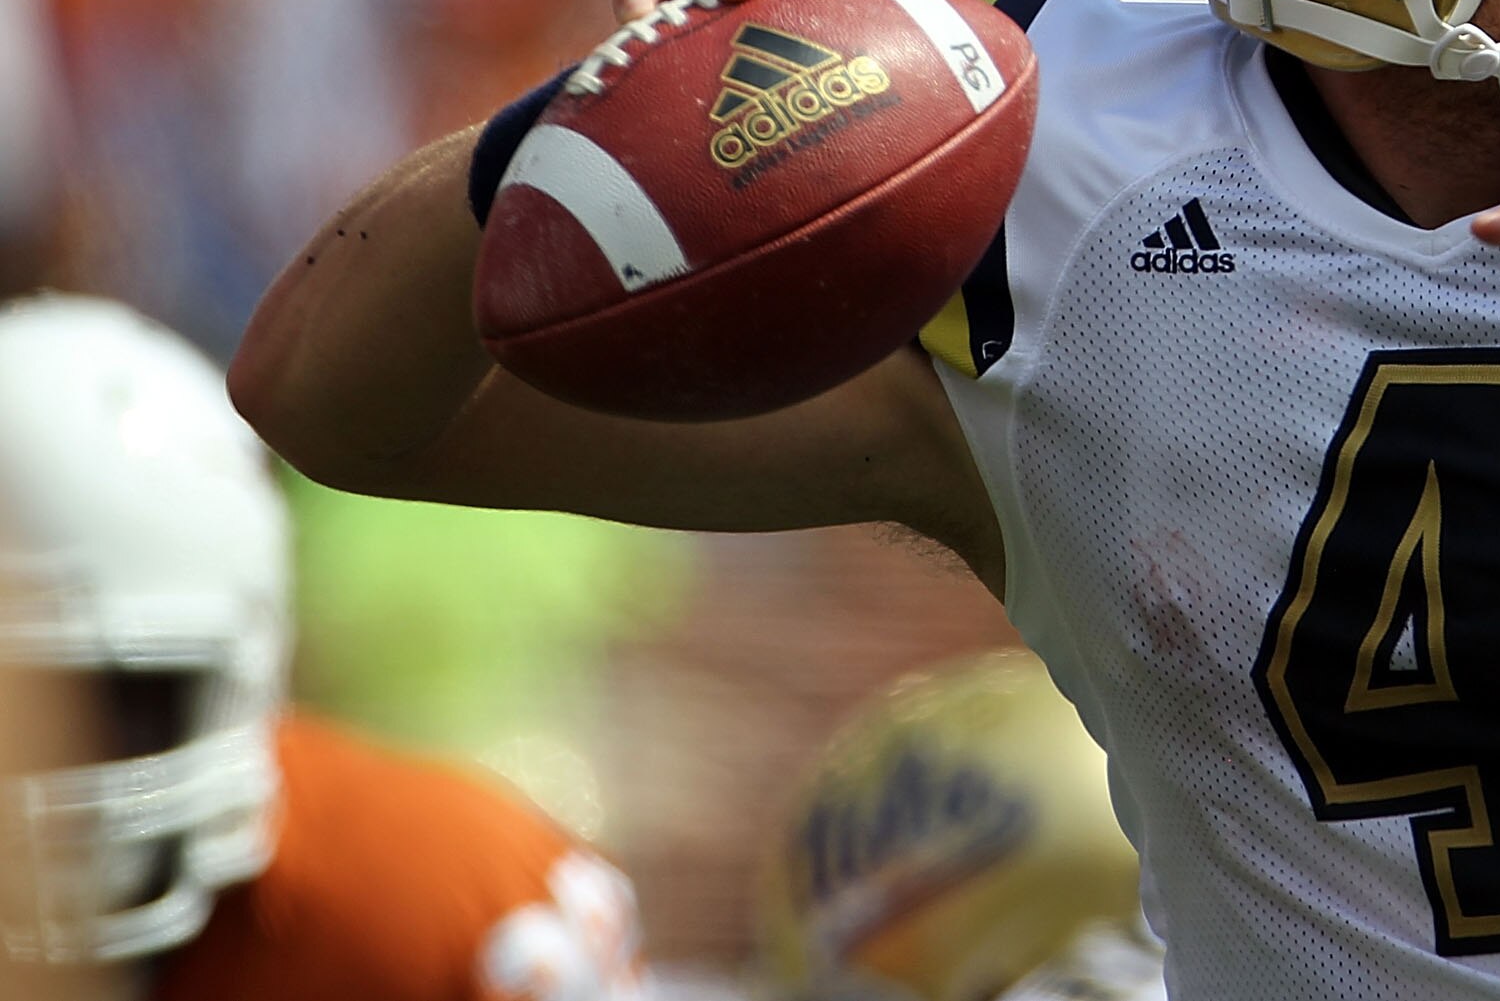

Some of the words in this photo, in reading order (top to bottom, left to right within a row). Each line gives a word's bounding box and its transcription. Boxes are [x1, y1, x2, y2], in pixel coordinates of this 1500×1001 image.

[949, 43, 991, 91] PG
[709, 54, 891, 169] adidas
[1130, 248, 1236, 274] adidas
